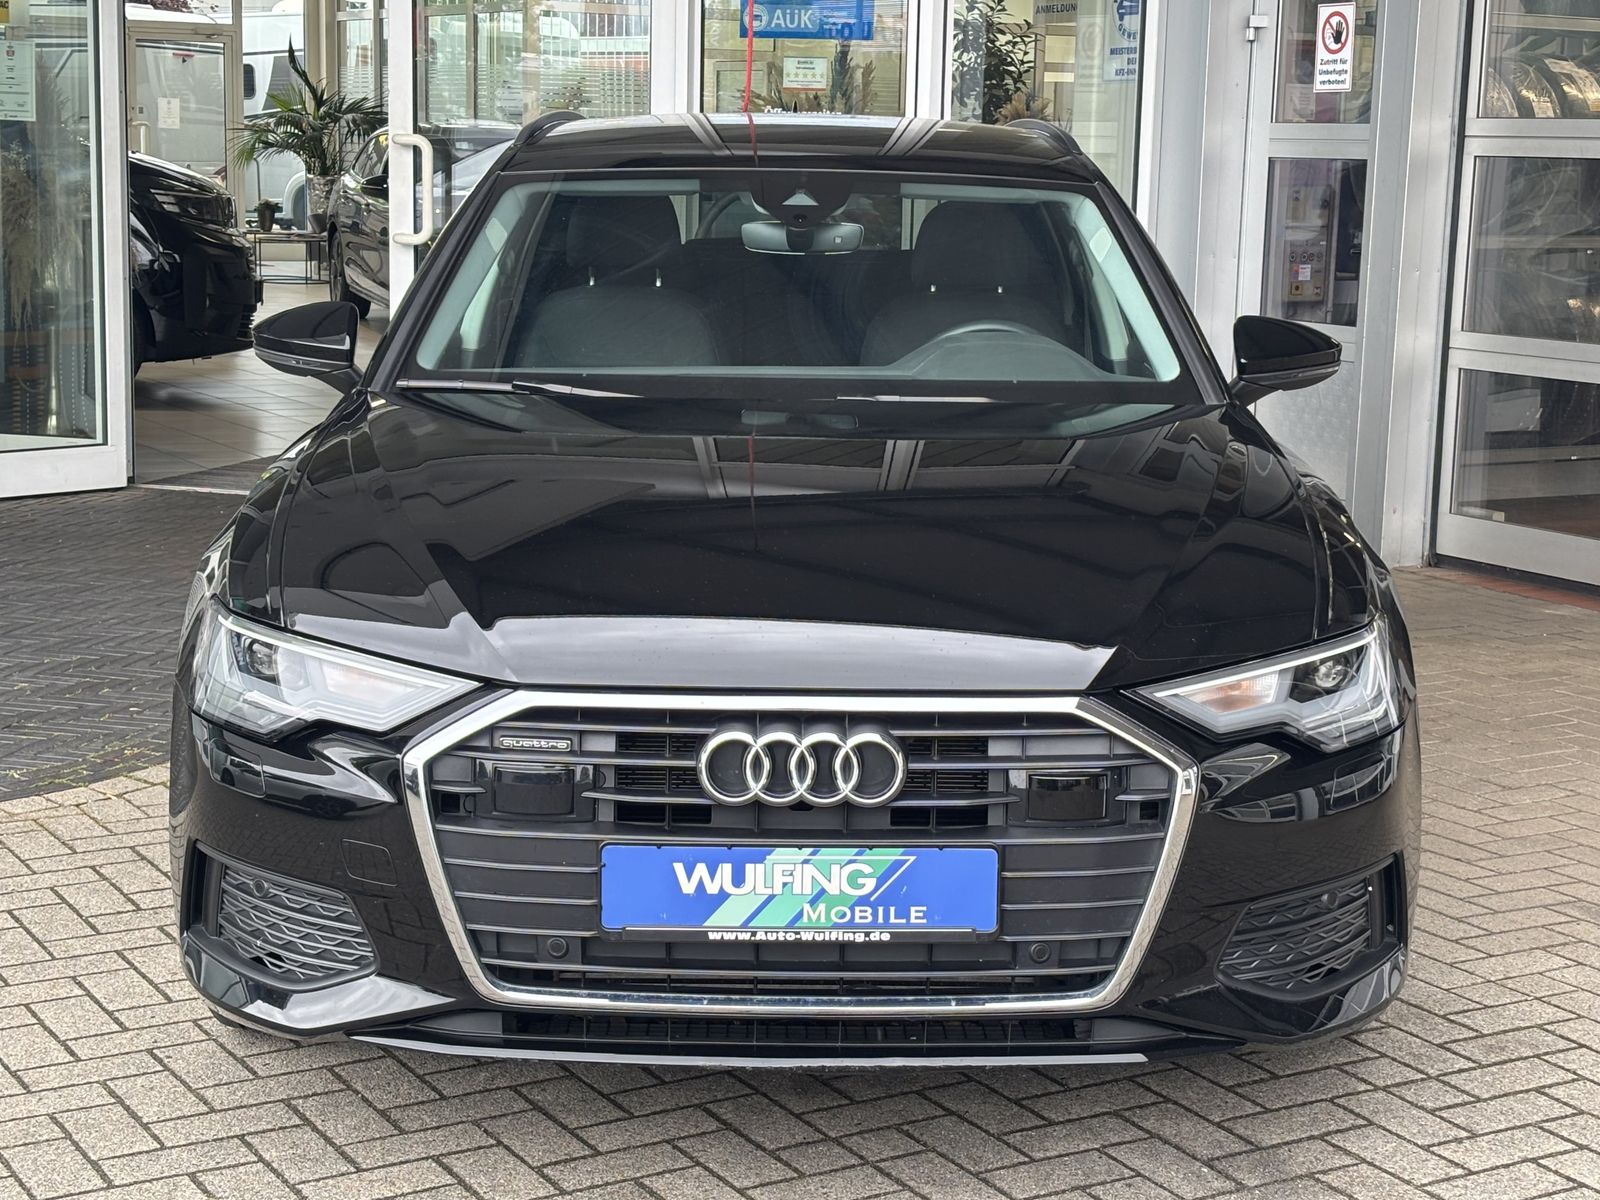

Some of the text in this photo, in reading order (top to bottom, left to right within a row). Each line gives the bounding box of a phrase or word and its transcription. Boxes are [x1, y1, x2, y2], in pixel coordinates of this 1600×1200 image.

[1035, 3, 1078, 15] ANMELDUN
[1318, 68, 1348, 76] Unbefugte
[1319, 78, 1346, 86] verboten!
[502, 740, 568, 749] quattro
[672, 862, 877, 896] WULFING
[802, 903, 928, 924] MOBILE
[707, 931, 891, 942] www.Auto-Wulfing.de
